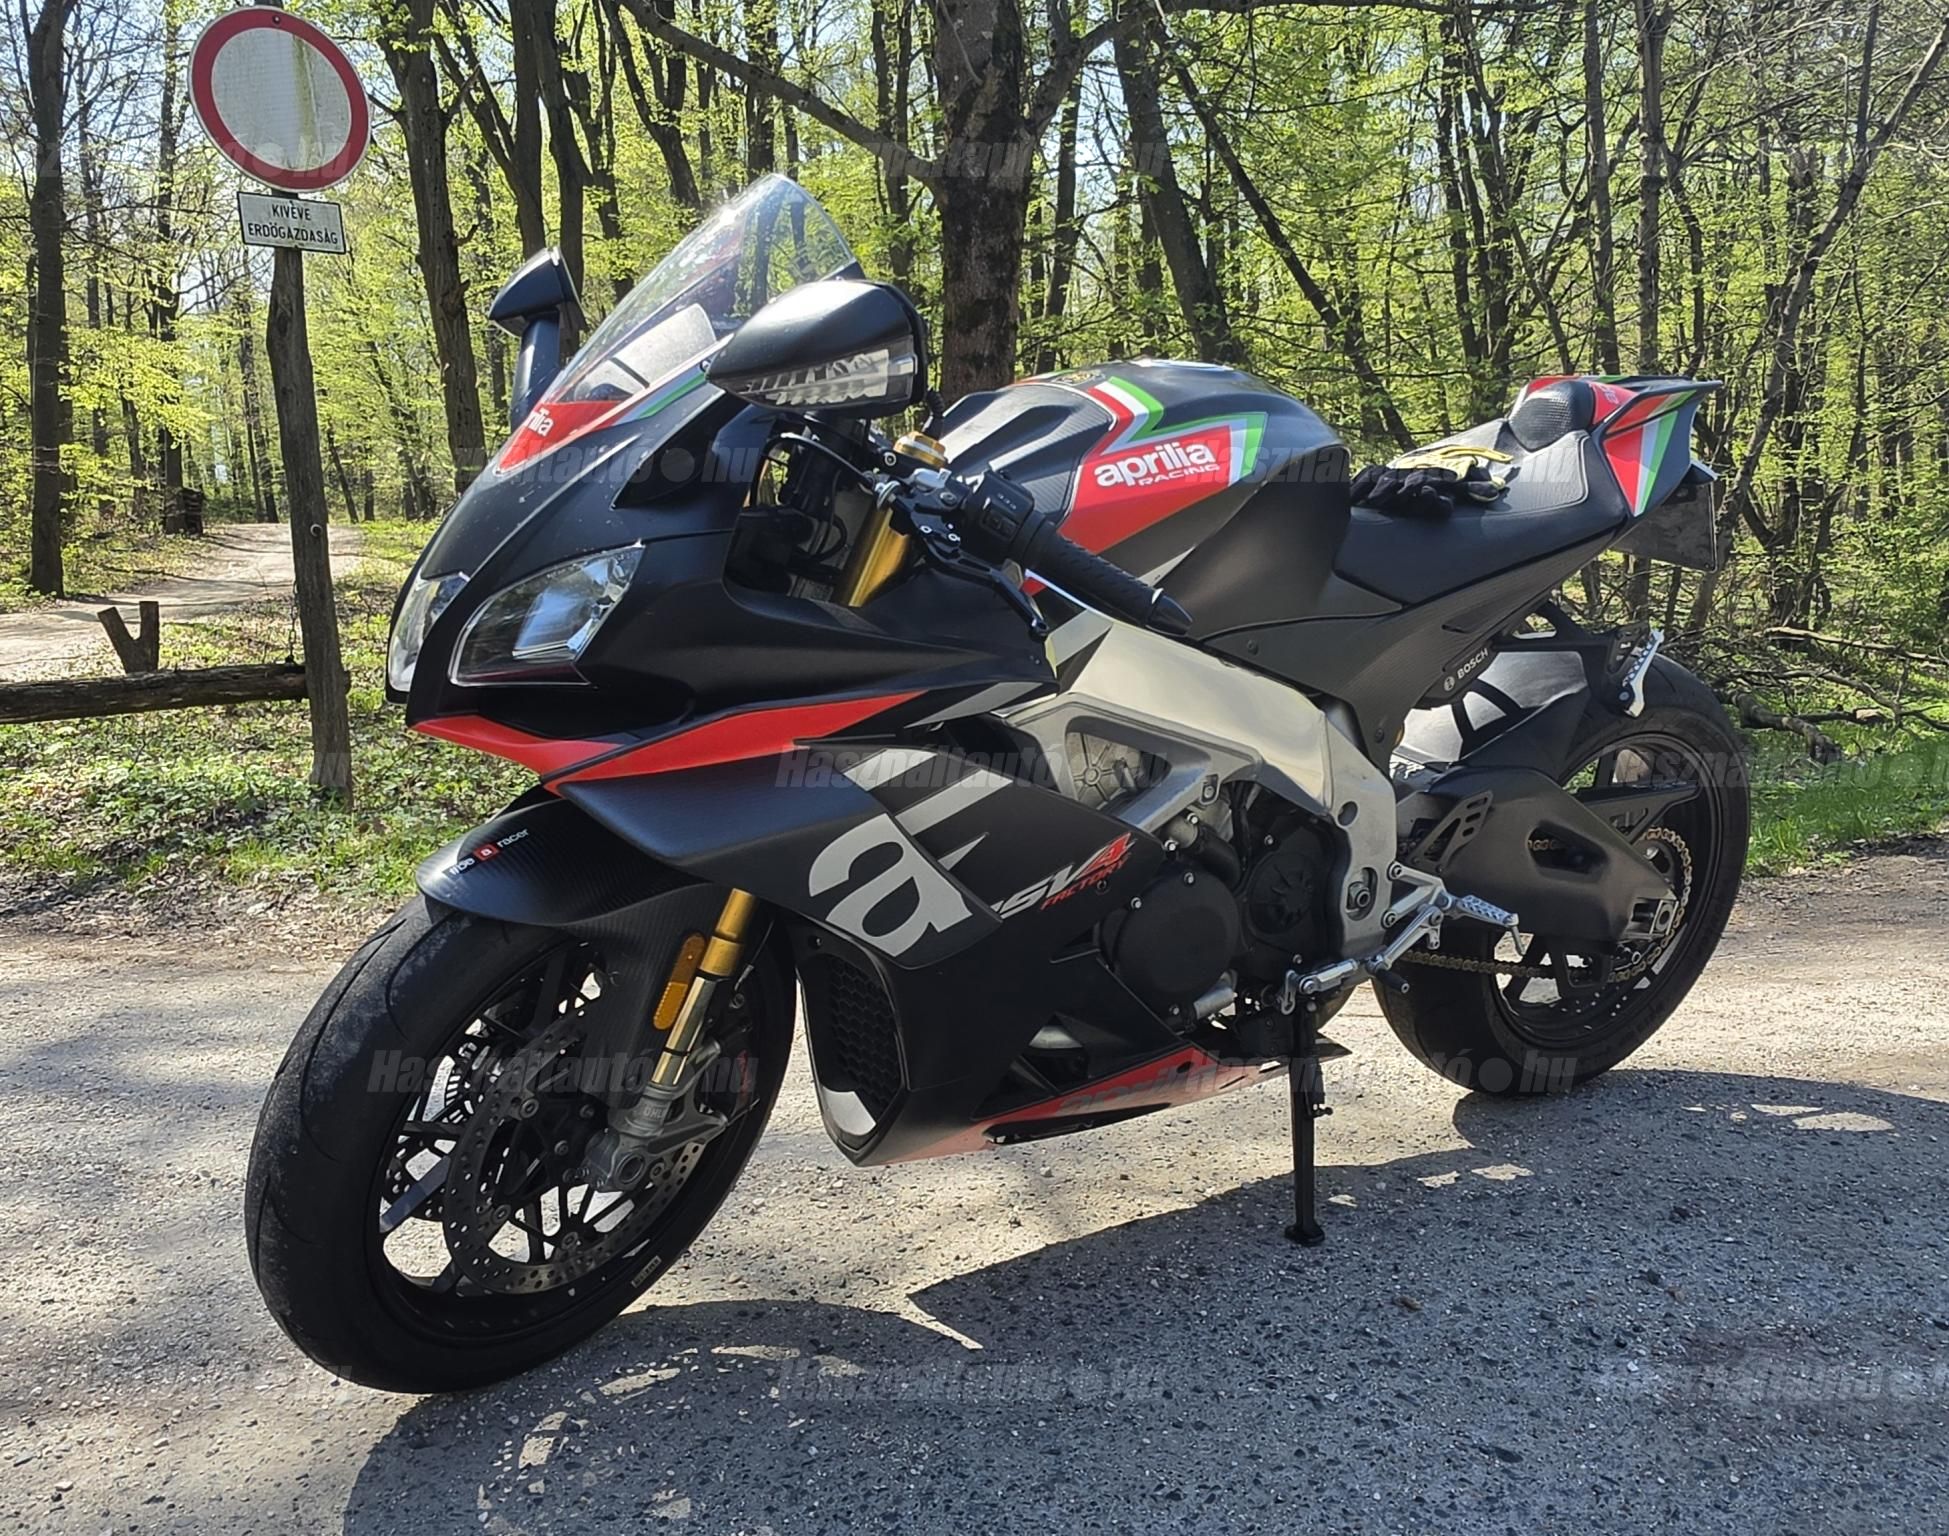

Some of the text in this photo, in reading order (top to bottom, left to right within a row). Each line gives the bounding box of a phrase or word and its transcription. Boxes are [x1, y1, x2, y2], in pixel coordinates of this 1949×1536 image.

[1094, 442, 1217, 487] aprilia
[1138, 463, 1221, 486] RACING
[1456, 647, 1489, 680] BOSCH
[496, 828, 530, 849] racer
[989, 832, 1136, 919] SV4
[1040, 853, 1132, 911] FACTORY
